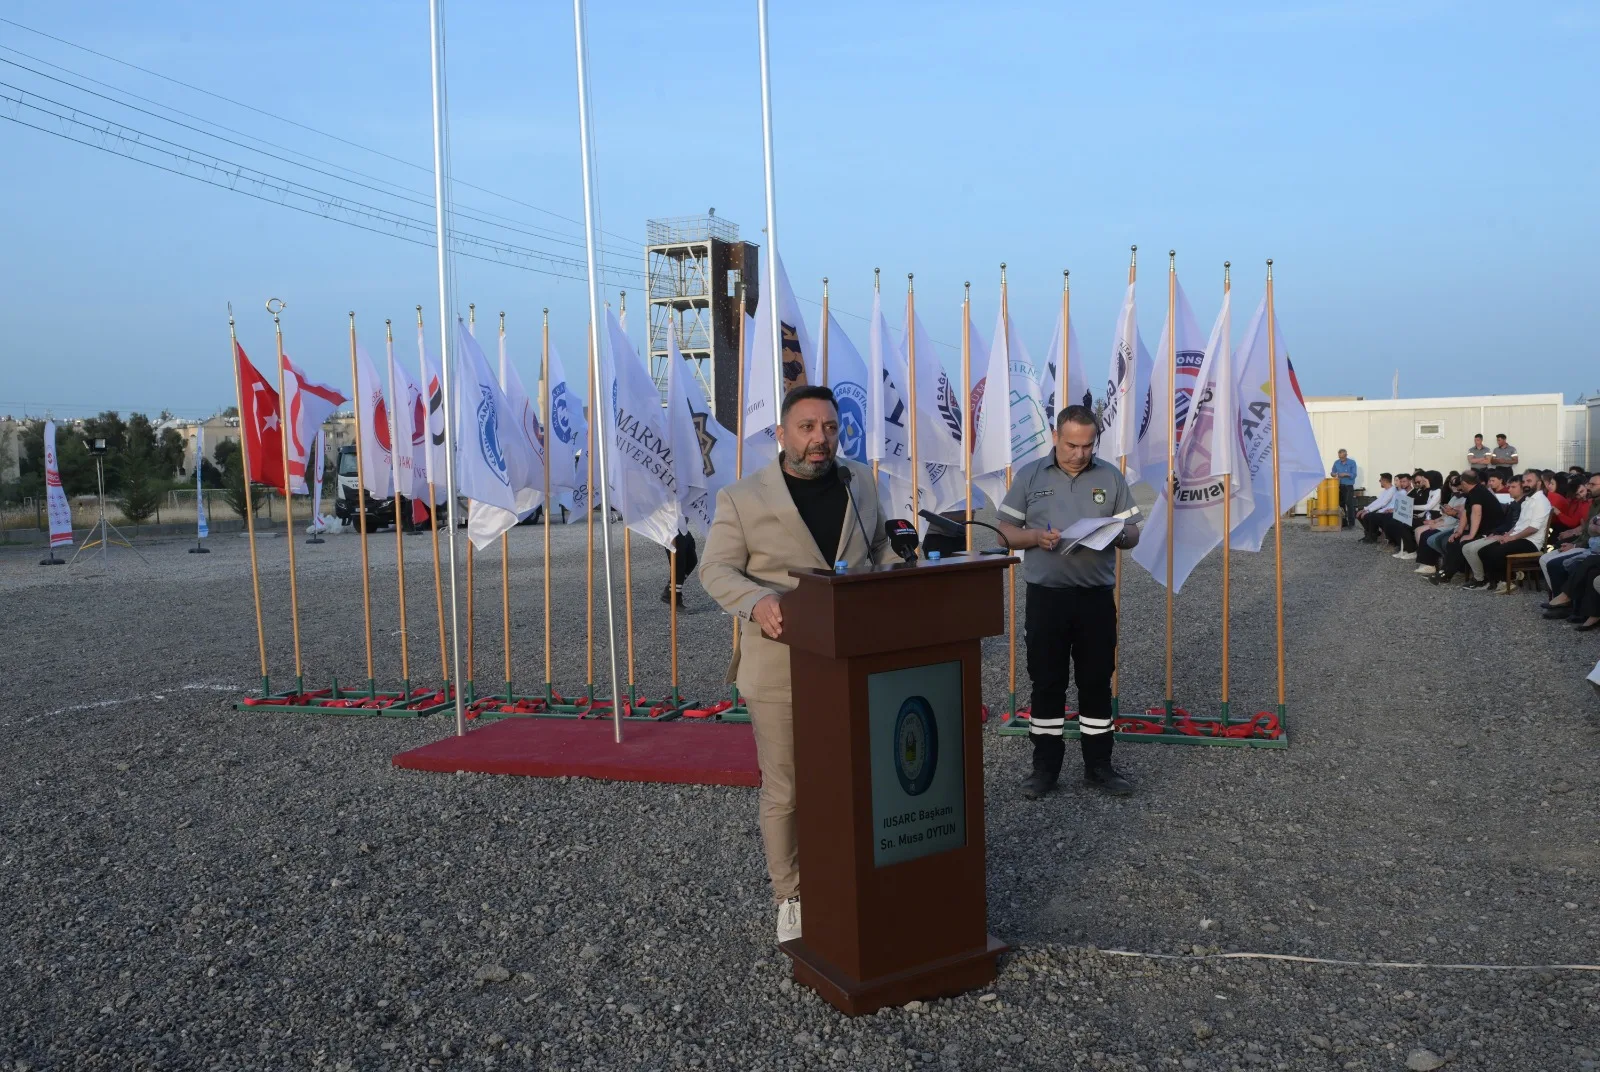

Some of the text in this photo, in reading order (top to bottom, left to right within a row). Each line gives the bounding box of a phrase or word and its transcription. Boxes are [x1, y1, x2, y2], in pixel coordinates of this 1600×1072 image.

[883, 806, 953, 829] IUSARC Başkanı
[880, 823, 956, 850] Sn. Musa OYTUN
